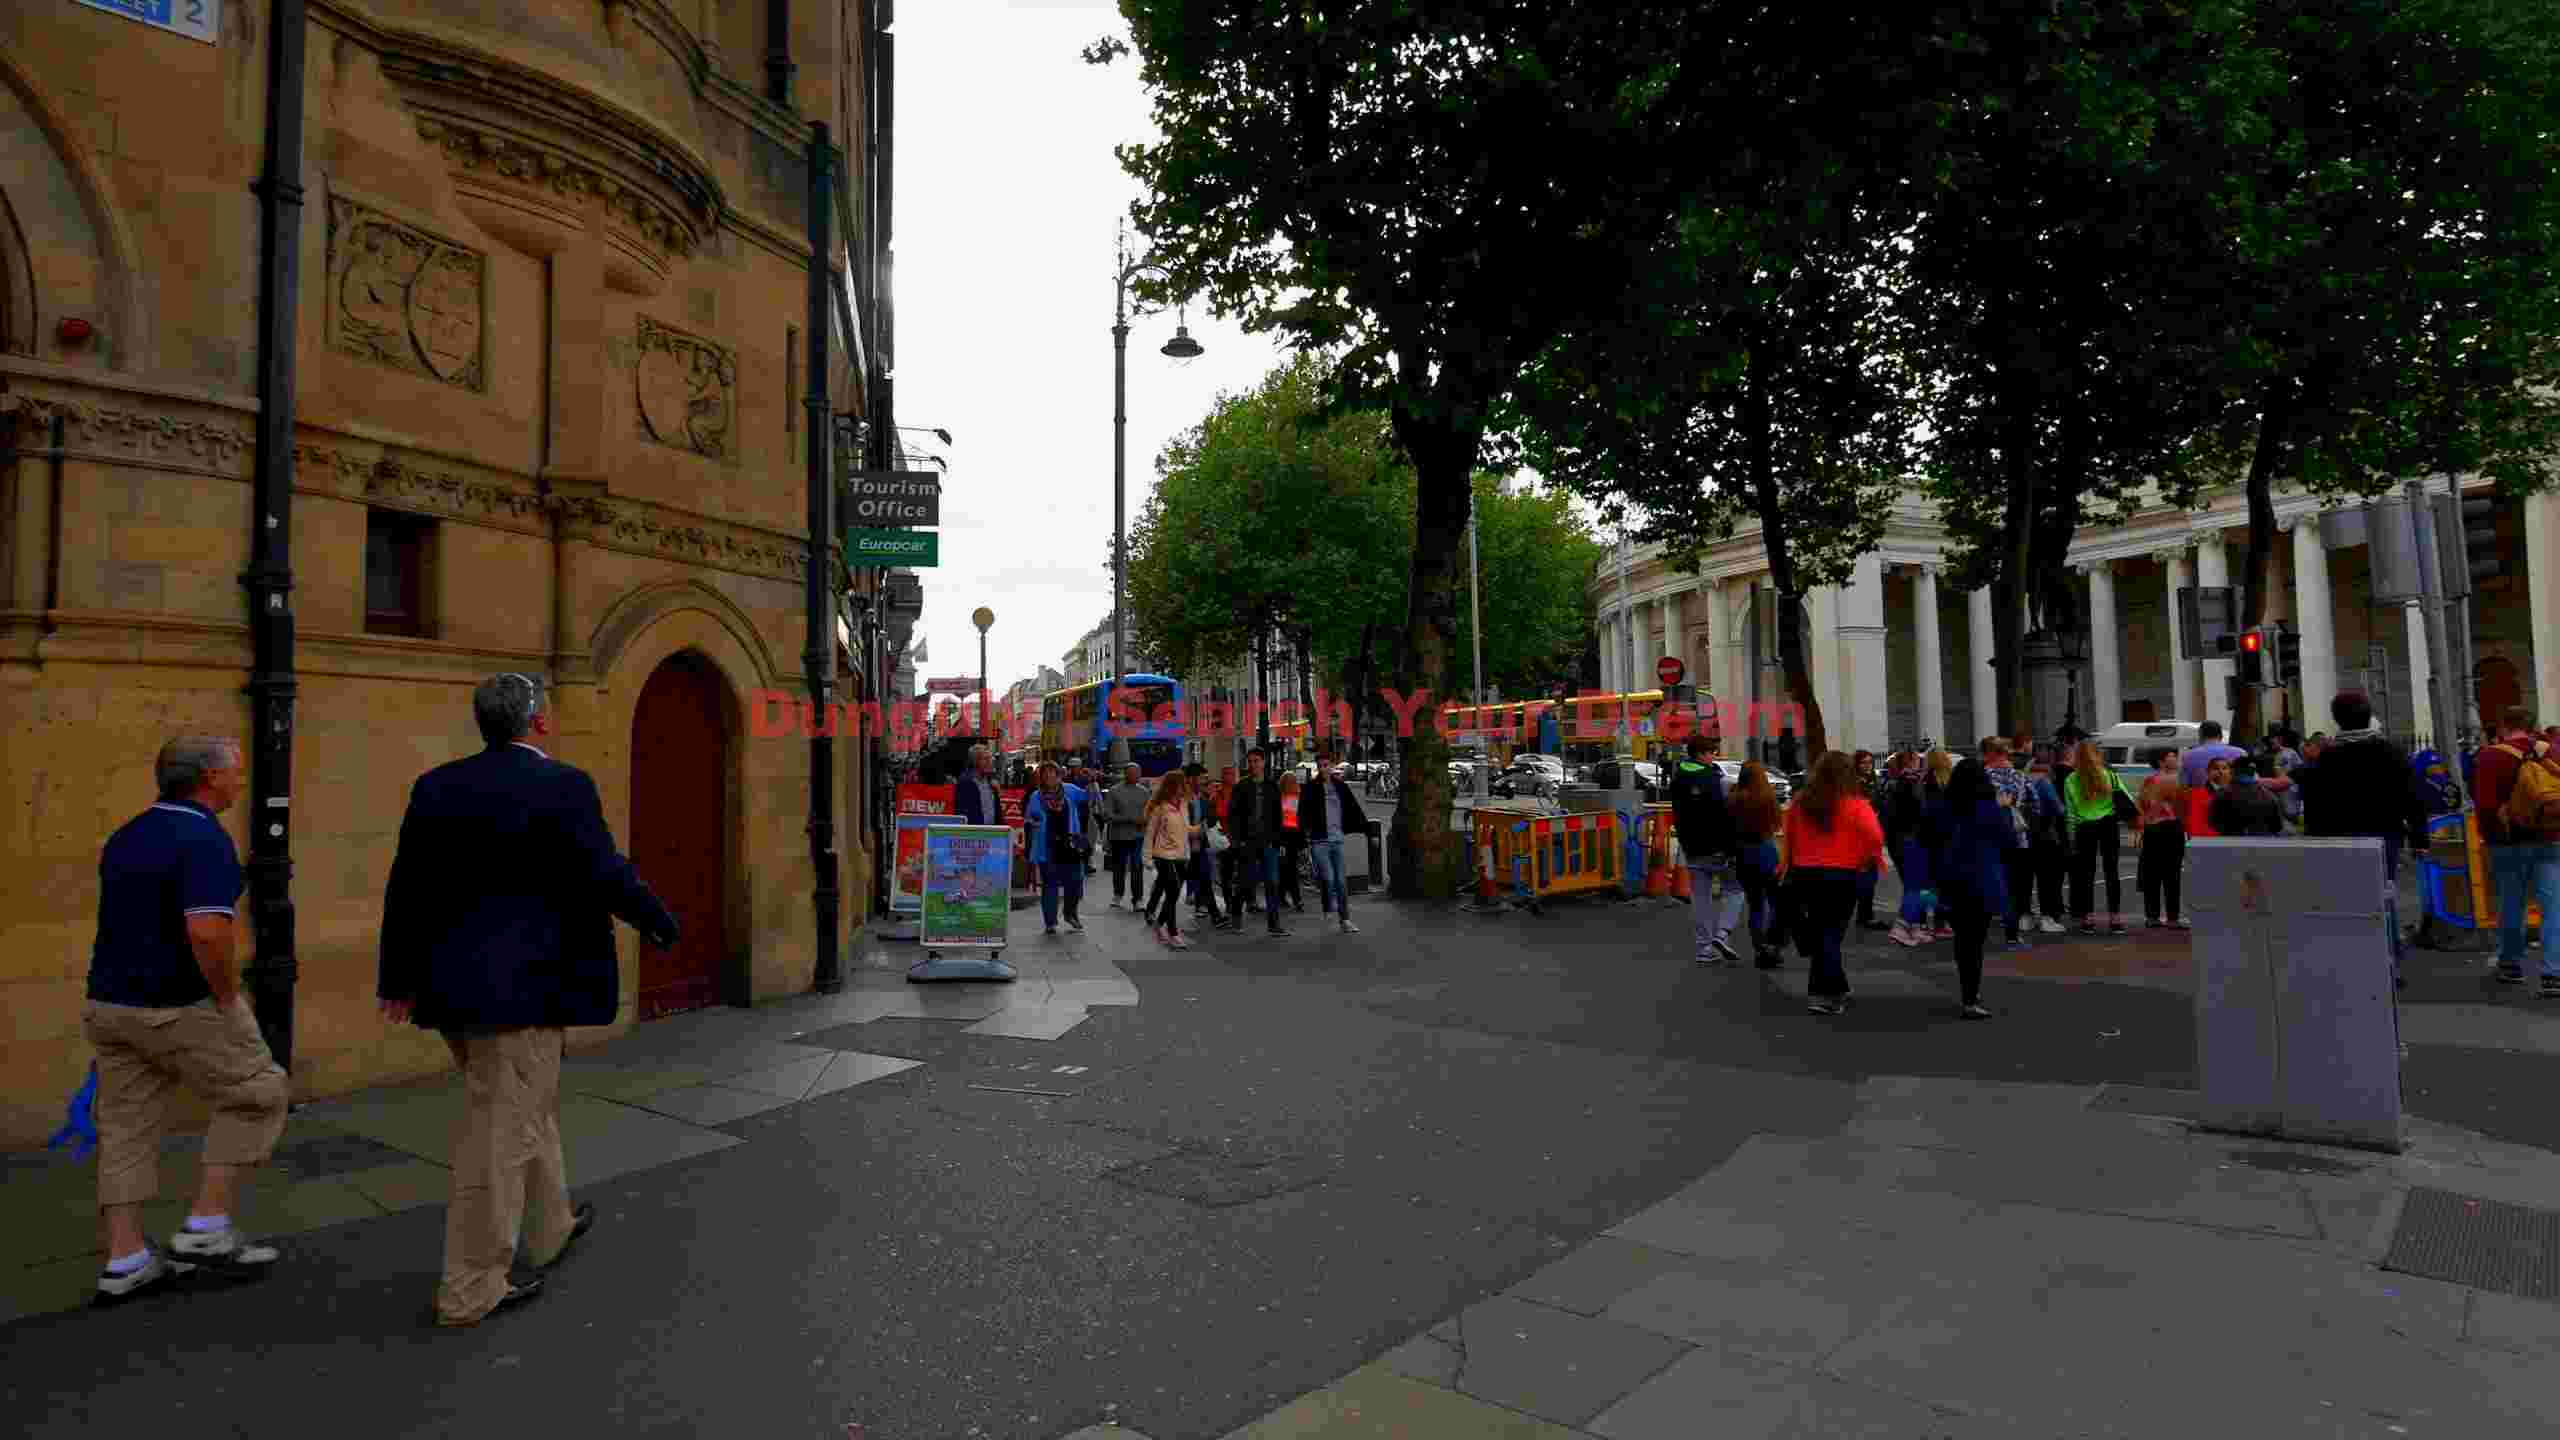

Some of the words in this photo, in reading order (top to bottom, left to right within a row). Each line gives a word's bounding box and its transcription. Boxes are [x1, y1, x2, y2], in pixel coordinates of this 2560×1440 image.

[849, 477, 937, 495] Tourism
[858, 500, 928, 518] Office
[859, 538, 929, 553] Europcar
